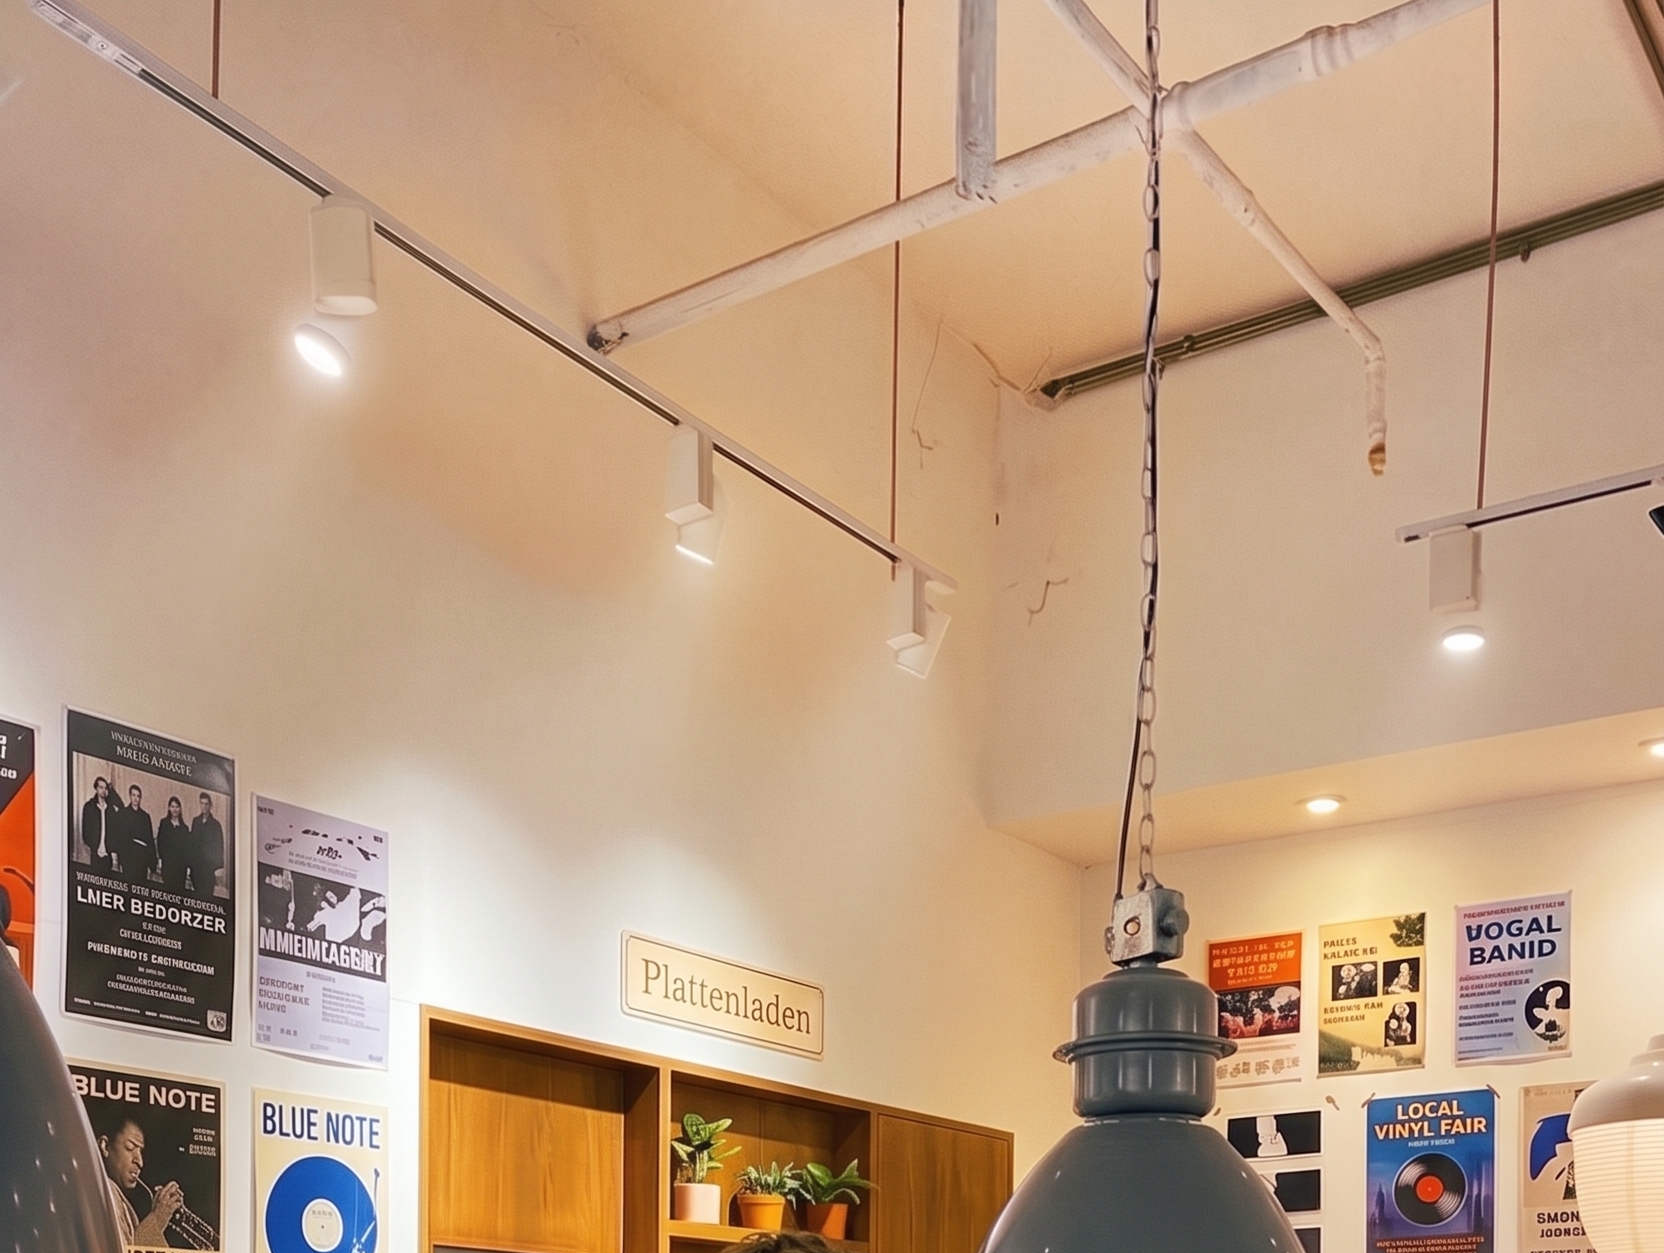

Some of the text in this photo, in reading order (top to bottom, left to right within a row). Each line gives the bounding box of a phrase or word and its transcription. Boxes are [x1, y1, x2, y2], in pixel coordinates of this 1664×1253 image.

[641, 957, 811, 1035] Plattenladen
[71, 1073, 216, 1114] BLUE NOTE
[1396, 1099, 1464, 1120] LOCAL
[262, 1101, 319, 1142] BLUE
[325, 1111, 380, 1150] NOTE
[1374, 1117, 1487, 1140] VINYL FAIR
